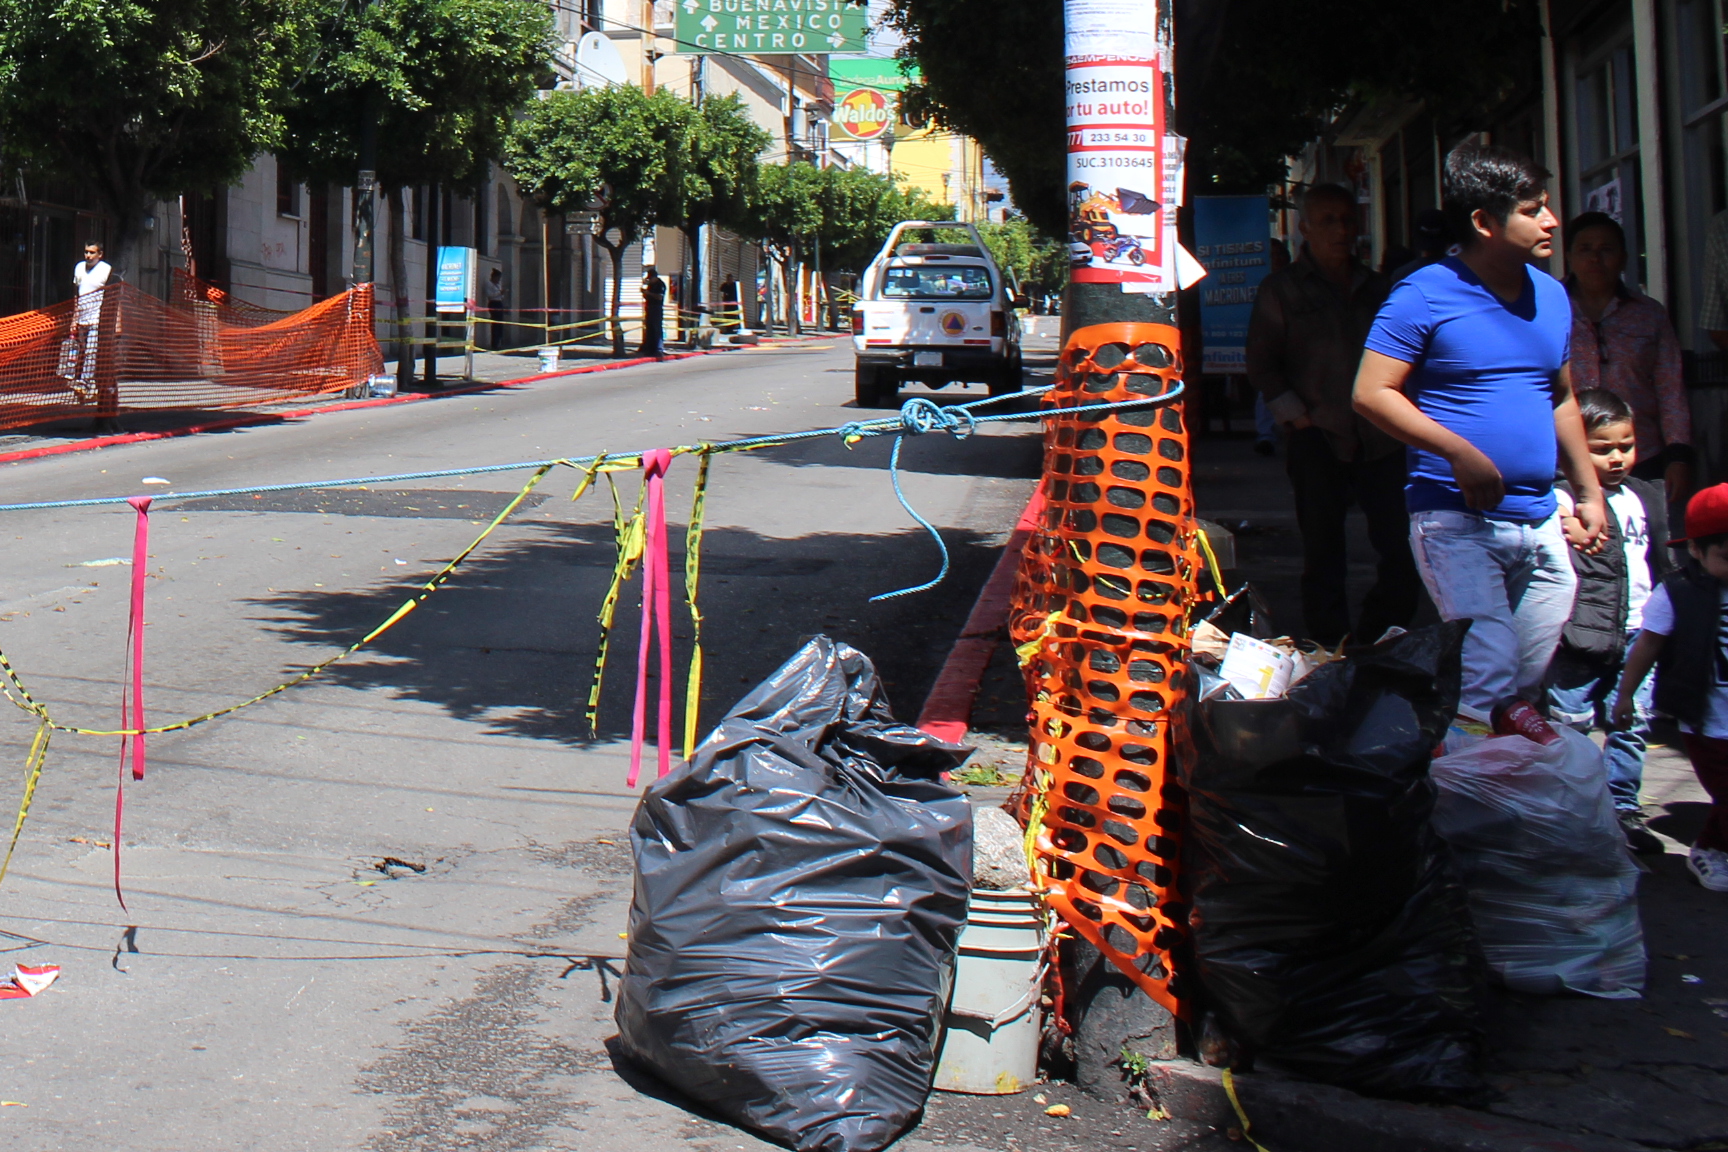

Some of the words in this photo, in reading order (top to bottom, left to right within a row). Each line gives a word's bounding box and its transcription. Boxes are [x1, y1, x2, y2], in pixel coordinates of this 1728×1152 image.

[736, 14, 842, 31] MEXICO
[695, 33, 805, 48] CENTRO
[833, 103, 896, 124] Waldo's
[1077, 102, 1093, 116] tu
[1097, 100, 1149, 116] auto!
[1090, 133, 1110, 142] 233
[1114, 133, 1128, 142] 54
[1133, 133, 1146, 142] 30
[1076, 157, 1153, 168] SUC.3103645
[1197, 245, 1210, 257] SI
